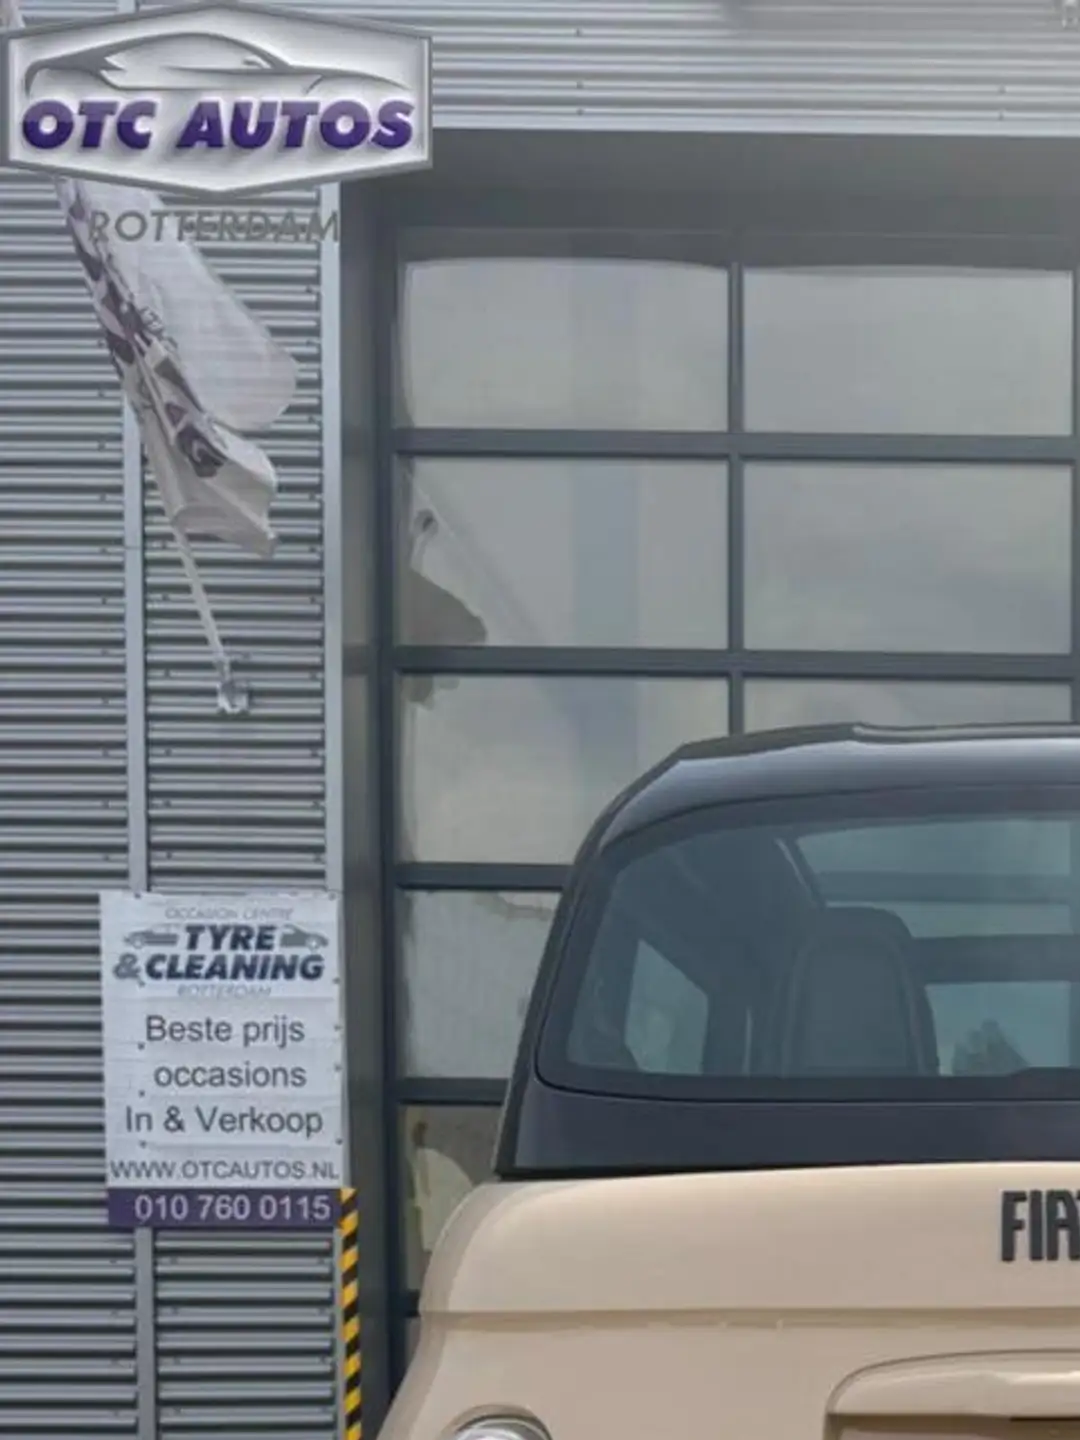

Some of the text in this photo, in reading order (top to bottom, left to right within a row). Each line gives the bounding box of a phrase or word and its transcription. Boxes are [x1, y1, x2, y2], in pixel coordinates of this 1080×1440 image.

[184, 925, 278, 951] TYRE
[145, 1014, 306, 1049] Beste prijs
[153, 1062, 308, 1089] occasions
[126, 1104, 324, 1139] In & Verkoop
[110, 1160, 340, 1180] WWW.OTCAUTOS.NL
[134, 1194, 331, 1221] 010 760 0115
